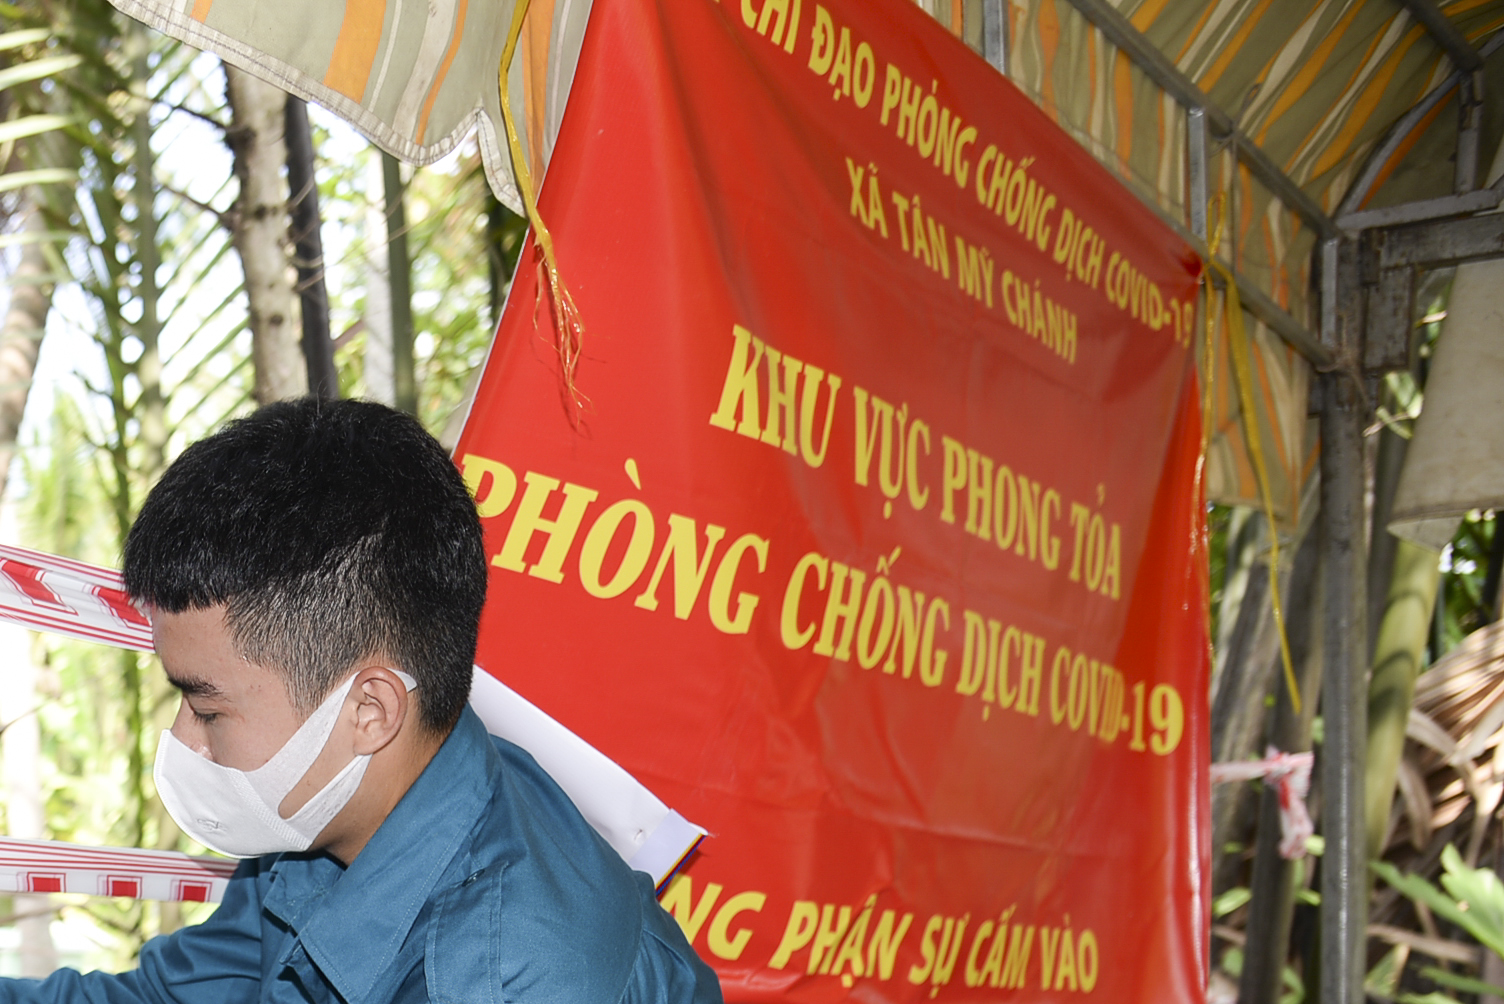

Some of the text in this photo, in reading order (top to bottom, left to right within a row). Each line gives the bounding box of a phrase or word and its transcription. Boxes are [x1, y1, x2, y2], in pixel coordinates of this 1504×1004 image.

[808, 4, 876, 108] ĐẠO
[976, 145, 1058, 251] CHỐNG
[1053, 208, 1106, 289] DỊCH
[892, 190, 950, 279] TÂN
[1001, 270, 1078, 364] CHÁNH
[709, 324, 842, 468] KHU
[854, 386, 932, 519] VỰC
[939, 436, 1063, 571] PHONG
[460, 453, 1185, 756] PHÒNG CHỐNG DỊCH COVID-19
[908, 911, 970, 998] SỰ
[1040, 911, 1099, 993] VÀO
